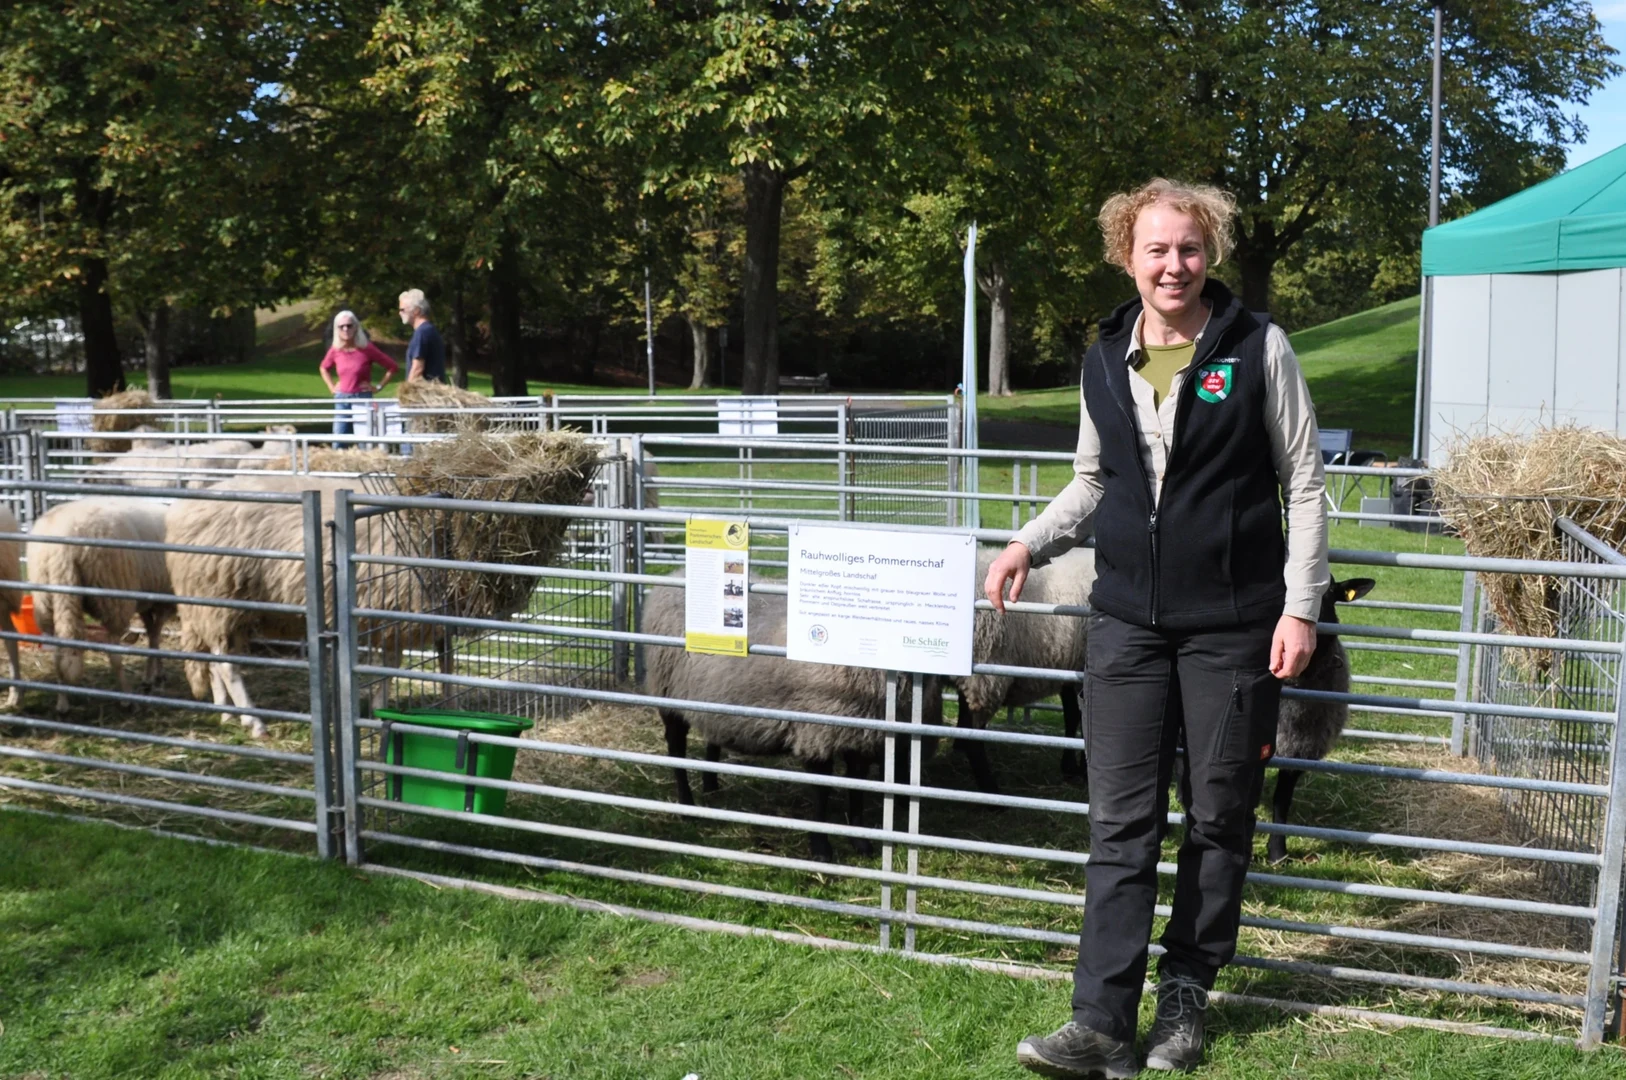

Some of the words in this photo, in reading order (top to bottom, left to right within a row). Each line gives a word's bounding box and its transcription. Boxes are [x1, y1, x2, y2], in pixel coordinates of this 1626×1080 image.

[800, 549, 865, 565] Rauhwolliges
[868, 554, 945, 568] Pommernschaf
[800, 568, 841, 577] Mittelgroßes
[843, 571, 877, 580] Landschaf
[902, 635, 917, 645] Die
[918, 636, 950, 647] Schäfer
